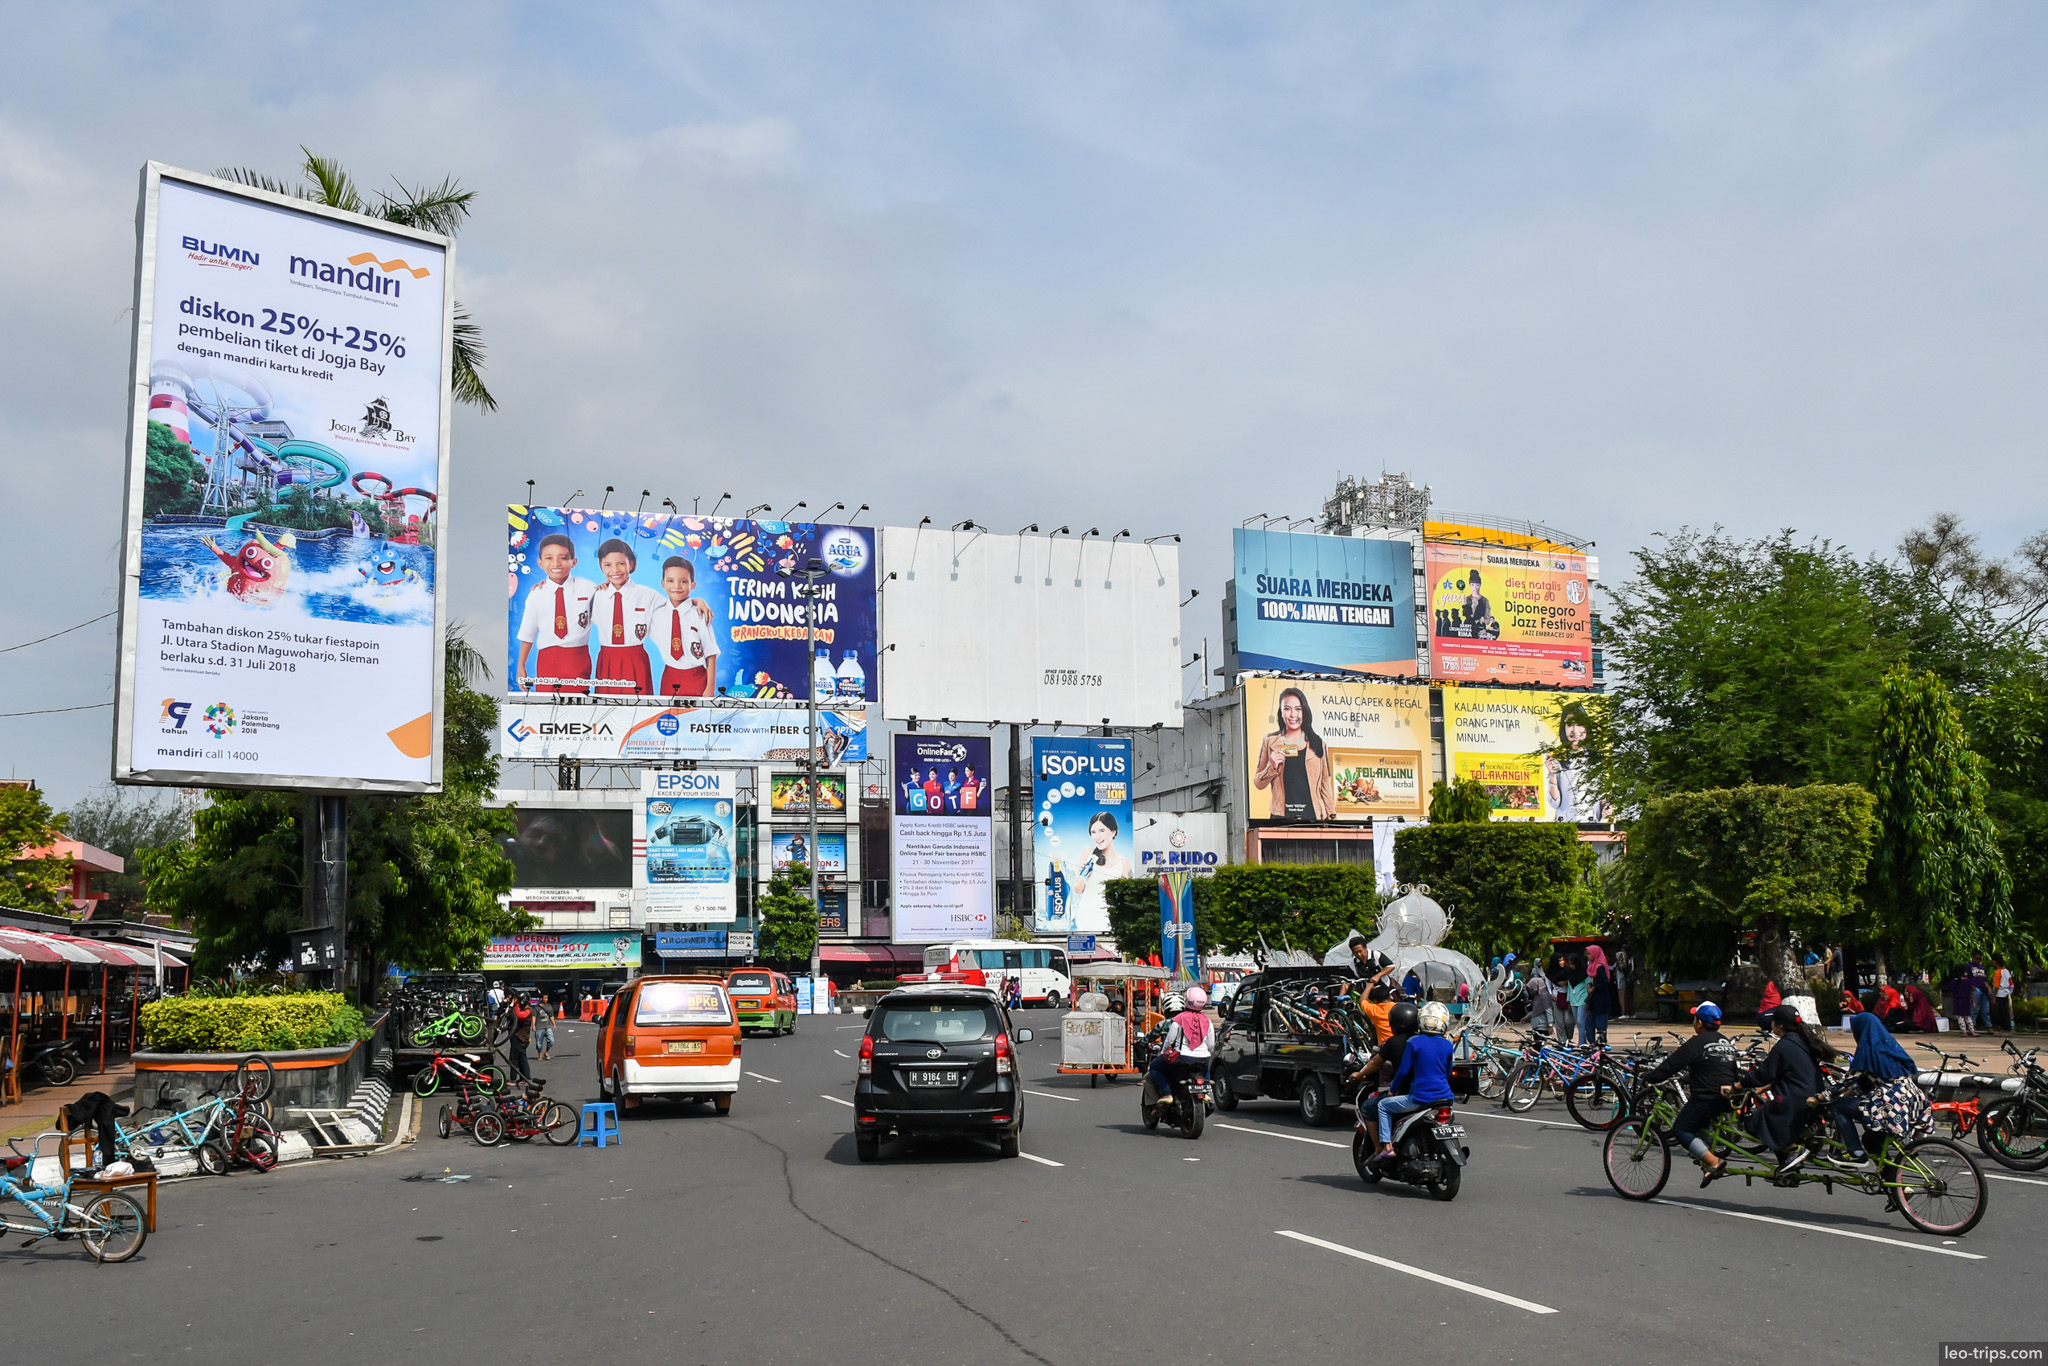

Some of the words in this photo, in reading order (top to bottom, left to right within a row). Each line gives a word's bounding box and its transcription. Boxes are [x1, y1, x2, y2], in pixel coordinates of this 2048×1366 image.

[182, 236, 259, 265] BUMN
[188, 252, 207, 262] Hadir
[209, 258, 229, 267] untuk
[231, 262, 252, 271] negeri
[290, 256, 400, 298] mandiri
[180, 296, 254, 328] diskon
[179, 323, 261, 349] pembelian
[265, 339, 298, 357] tiket
[301, 346, 315, 360] di
[319, 350, 356, 371] Jogja
[360, 357, 386, 376] Bay
[177, 342, 221, 358] dengan
[224, 352, 267, 368] mandiri
[270, 360, 299, 375] kartu
[301, 367, 334, 381] kredit
[828, 544, 862, 558] AQUA
[1487, 555, 1508, 565] SUARA
[1510, 557, 1540, 568] MERDEKA
[727, 577, 785, 599] TERIMA
[1256, 574, 1312, 597] SUARA
[1317, 579, 1393, 602] MERDEKA
[1505, 578, 1525, 588] dies
[1529, 580, 1561, 591] natalis
[1512, 590, 1540, 602] undip
[1544, 591, 1555, 602] 60
[1262, 601, 1300, 620] 100%
[1301, 604, 1338, 622] JAWA
[1340, 606, 1390, 625] TENGAH
[1505, 600, 1575, 617] Diponegoro
[1512, 616, 1536, 629] Jazz
[1541, 618, 1585, 631] Festival
[162, 619, 223, 635] Tambahan
[226, 626, 264, 639] diskon
[267, 630, 291, 641] 25%
[294, 634, 323, 645] tukar
[326, 636, 380, 650] fiestapoin
[733, 625, 832, 643] #RANGKULKEBAKAN
[161, 635, 172, 646] Jl.
[176, 636, 207, 649] Utara
[211, 640, 254, 654] Stadion
[257, 645, 337, 662] Maguwoharjo,
[340, 653, 379, 665] Sleman
[161, 650, 205, 664] berlaku
[208, 656, 227, 666] s.d.
[230, 658, 242, 667] 31
[246, 659, 265, 670] Juli
[268, 661, 296, 672] 2018
[1044, 674, 1060, 685] 081
[1062, 674, 1078, 685] 988
[1080, 675, 1102, 686] 5758
[1322, 695, 1352, 705] KALAU
[1355, 697, 1384, 707] CAPEK
[1386, 698, 1392, 707] &
[1395, 699, 1422, 709] PEGAL
[1455, 702, 1484, 712] KALAU
[1487, 705, 1519, 713] MASUK
[1521, 706, 1549, 714] ANGIN
[1323, 711, 1348, 721] YANG
[1351, 713, 1380, 722] BENAR
[1456, 718, 1487, 727] ORANG
[1490, 719, 1520, 728] PINTAR
[242, 721, 280, 729] Palembang
[690, 724, 731, 733] FASTER
[770, 726, 799, 734] FIBER
[157, 748, 202, 757] mandiri
[206, 750, 223, 759] call
[227, 751, 258, 761] 14000
[917, 748, 954, 756] OnlineFair
[1042, 755, 1125, 775] ISOPLUS
[658, 775, 719, 789] EPSON
[1107, 790, 1126, 799] ION
[1142, 851, 1166, 864] PT.
[1169, 851, 1218, 865] RUDO
[1054, 877, 1063, 914] ISOPLUS
[950, 914, 973, 922] HSBC
[515, 935, 560, 943] OPERASI
[486, 944, 522, 952] ZEBRA
[524, 944, 558, 952] CANDI
[562, 943, 589, 951] 2017
[688, 997, 718, 1006] BPKB
[912, 1073, 917, 1081] H
[923, 1072, 940, 1081] 9164
[947, 1072, 956, 1080] EH
